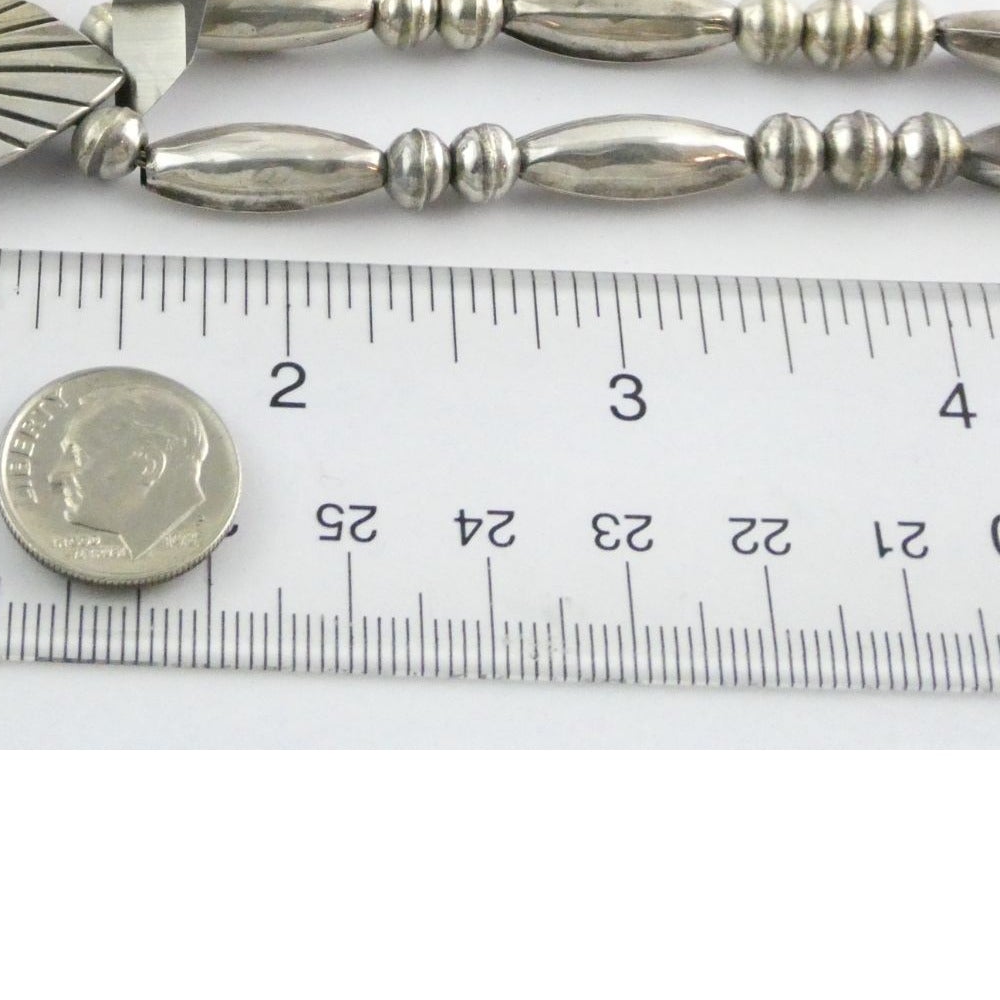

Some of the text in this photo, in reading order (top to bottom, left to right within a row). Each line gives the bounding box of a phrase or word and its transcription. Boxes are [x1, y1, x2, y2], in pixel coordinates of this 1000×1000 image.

[269, 361, 308, 410] 2
[609, 374, 648, 423] 3
[938, 382, 979, 430] 4
[7, 385, 69, 504] LIBERTY
[316, 502, 379, 544] 25
[453, 508, 517, 549] 24
[591, 512, 655, 553] 23
[728, 517, 793, 557] 22
[874, 520, 930, 561] 21
